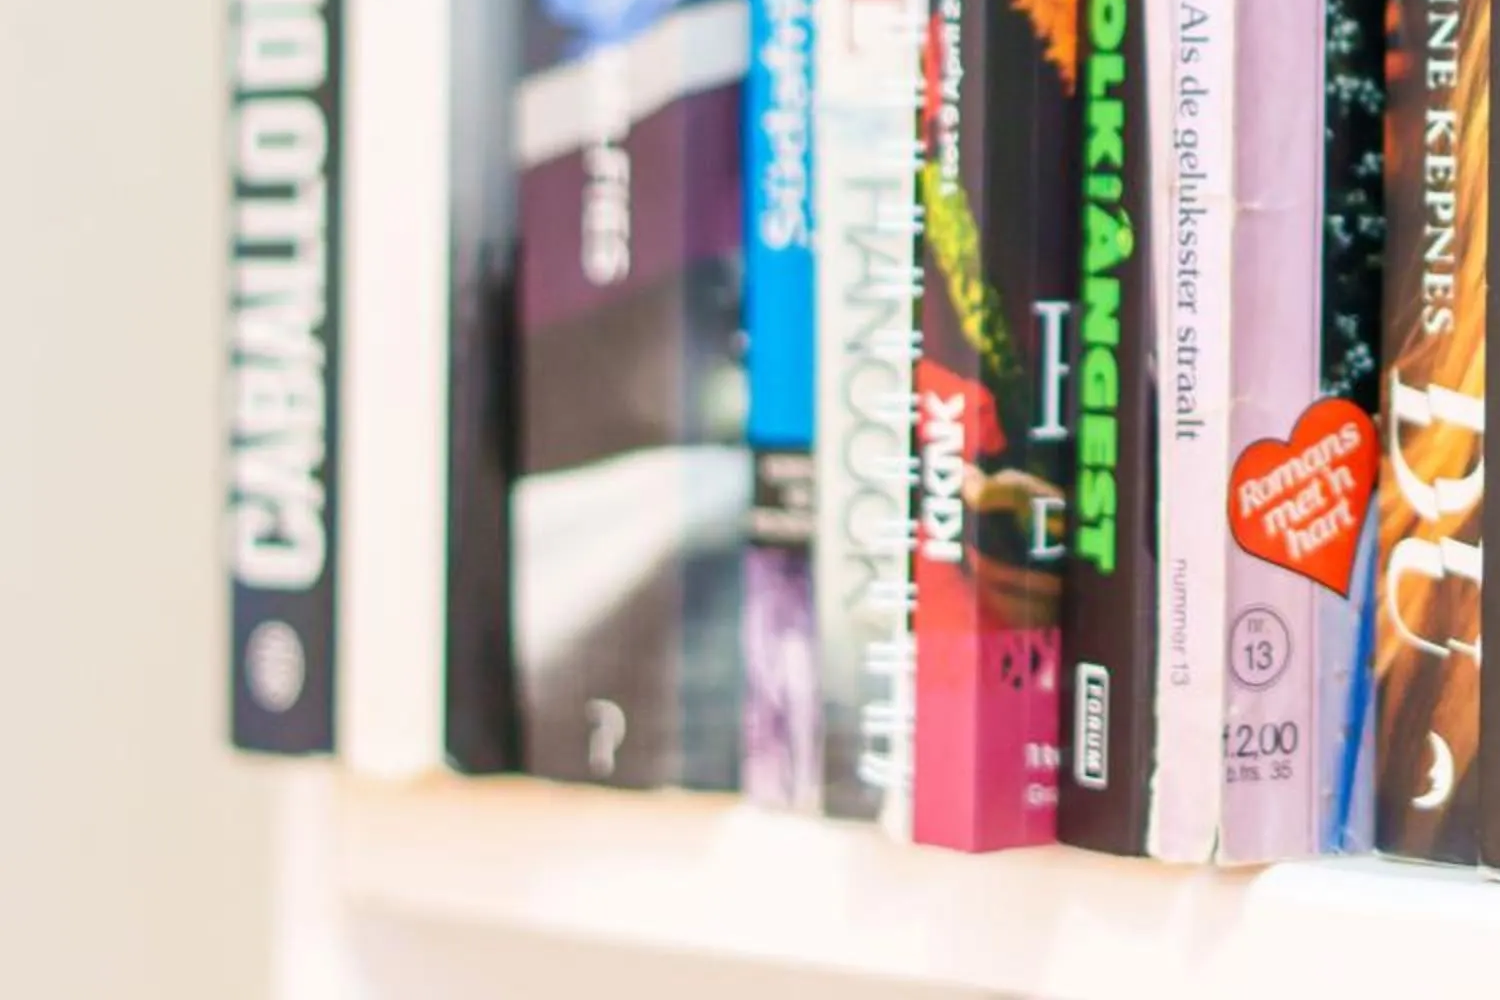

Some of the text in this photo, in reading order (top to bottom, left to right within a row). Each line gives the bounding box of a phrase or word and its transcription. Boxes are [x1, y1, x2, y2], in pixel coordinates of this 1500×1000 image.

[1172, 1, 1209, 442] Als de geluksster straalt
[1422, 108, 1459, 336] KEPNES
[230, 97, 327, 591] CABALLO
[920, 389, 966, 562] KKNK
[1238, 421, 1362, 519] Romans
[1263, 479, 1328, 539] met
[1285, 498, 1355, 560] hart
[1170, 558, 1190, 688] nummer 13
[1243, 639, 1274, 672] 13
